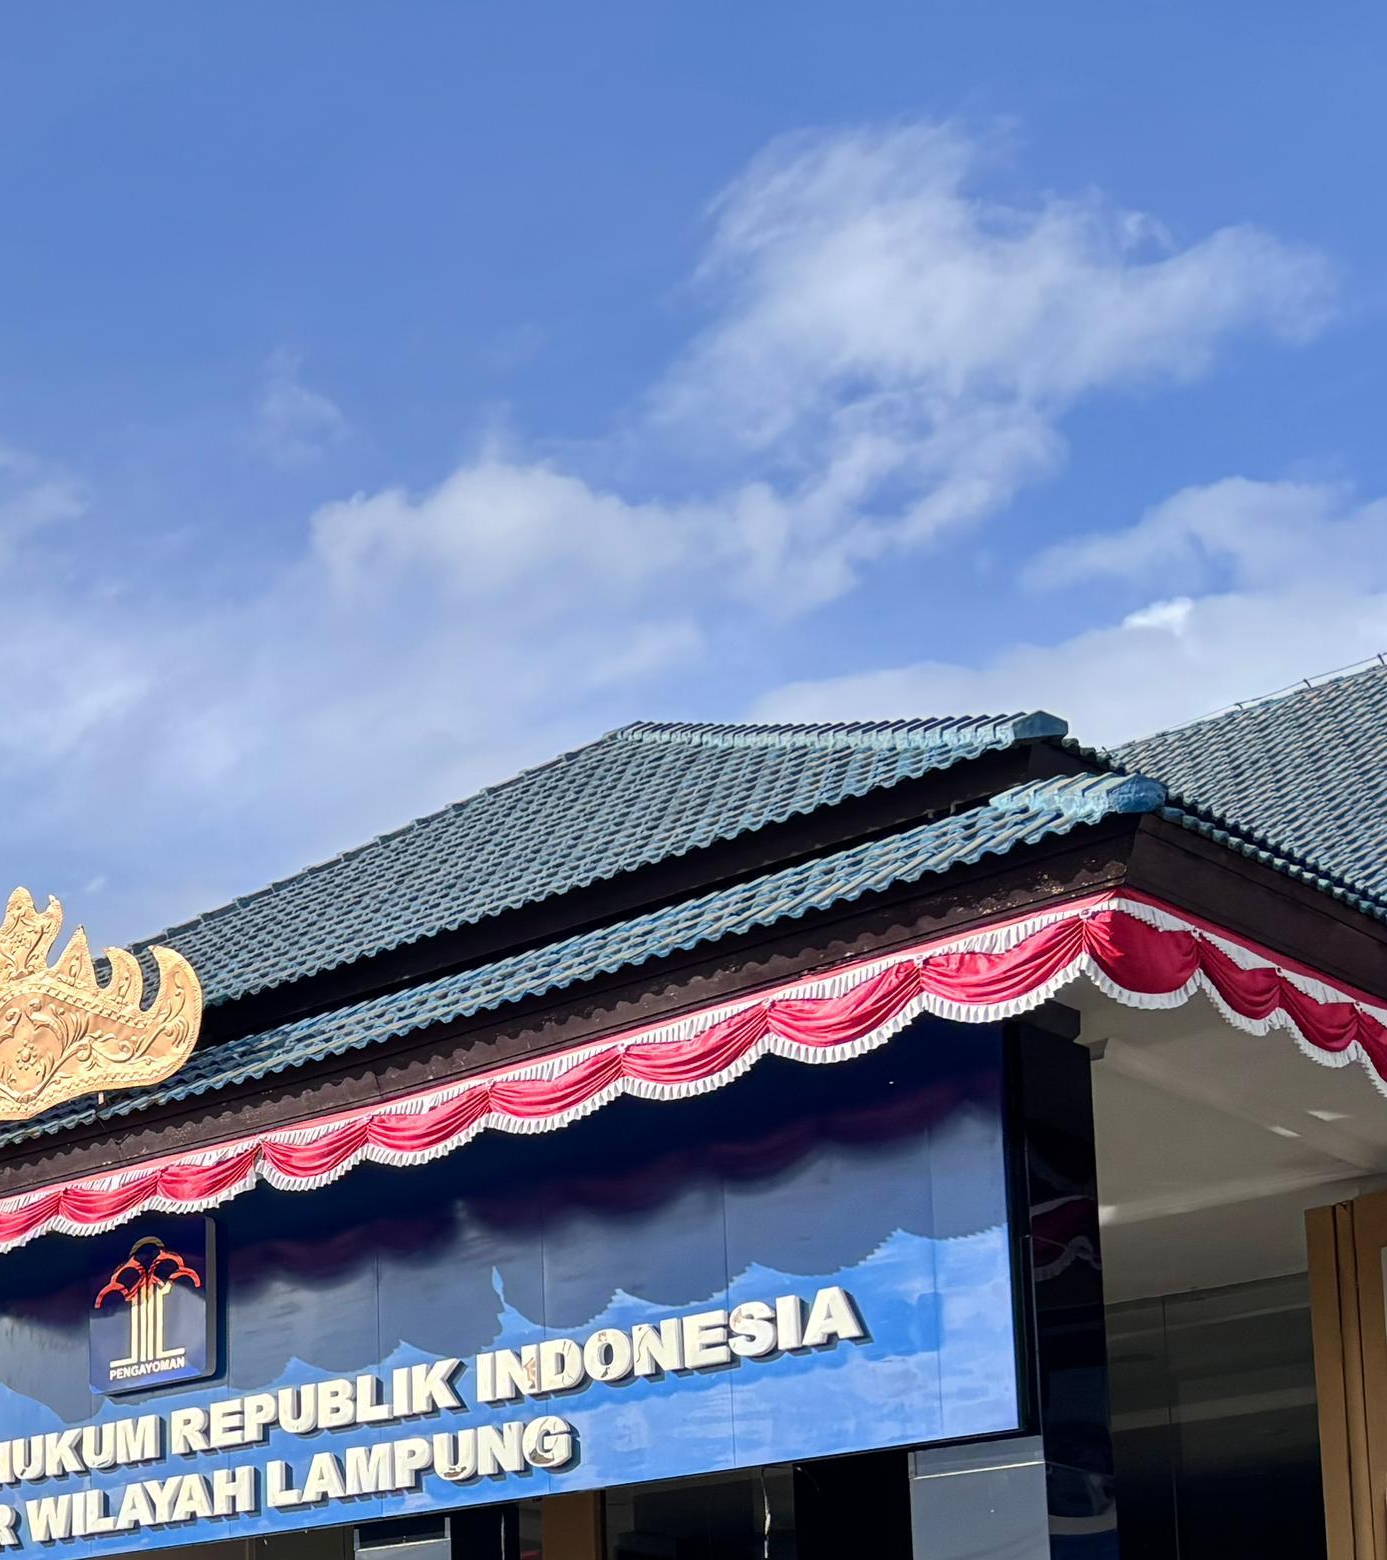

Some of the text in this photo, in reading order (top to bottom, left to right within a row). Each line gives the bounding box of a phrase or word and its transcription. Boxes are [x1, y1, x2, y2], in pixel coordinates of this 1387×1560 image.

[109, 1356, 185, 1381] PENGAYOMAN
[170, 1357, 463, 1457] REPUBLIK
[476, 1285, 869, 1403] INDONESIA
[25, 1464, 257, 1546] WILAYAH
[265, 1415, 574, 1507] LAMPUNG
